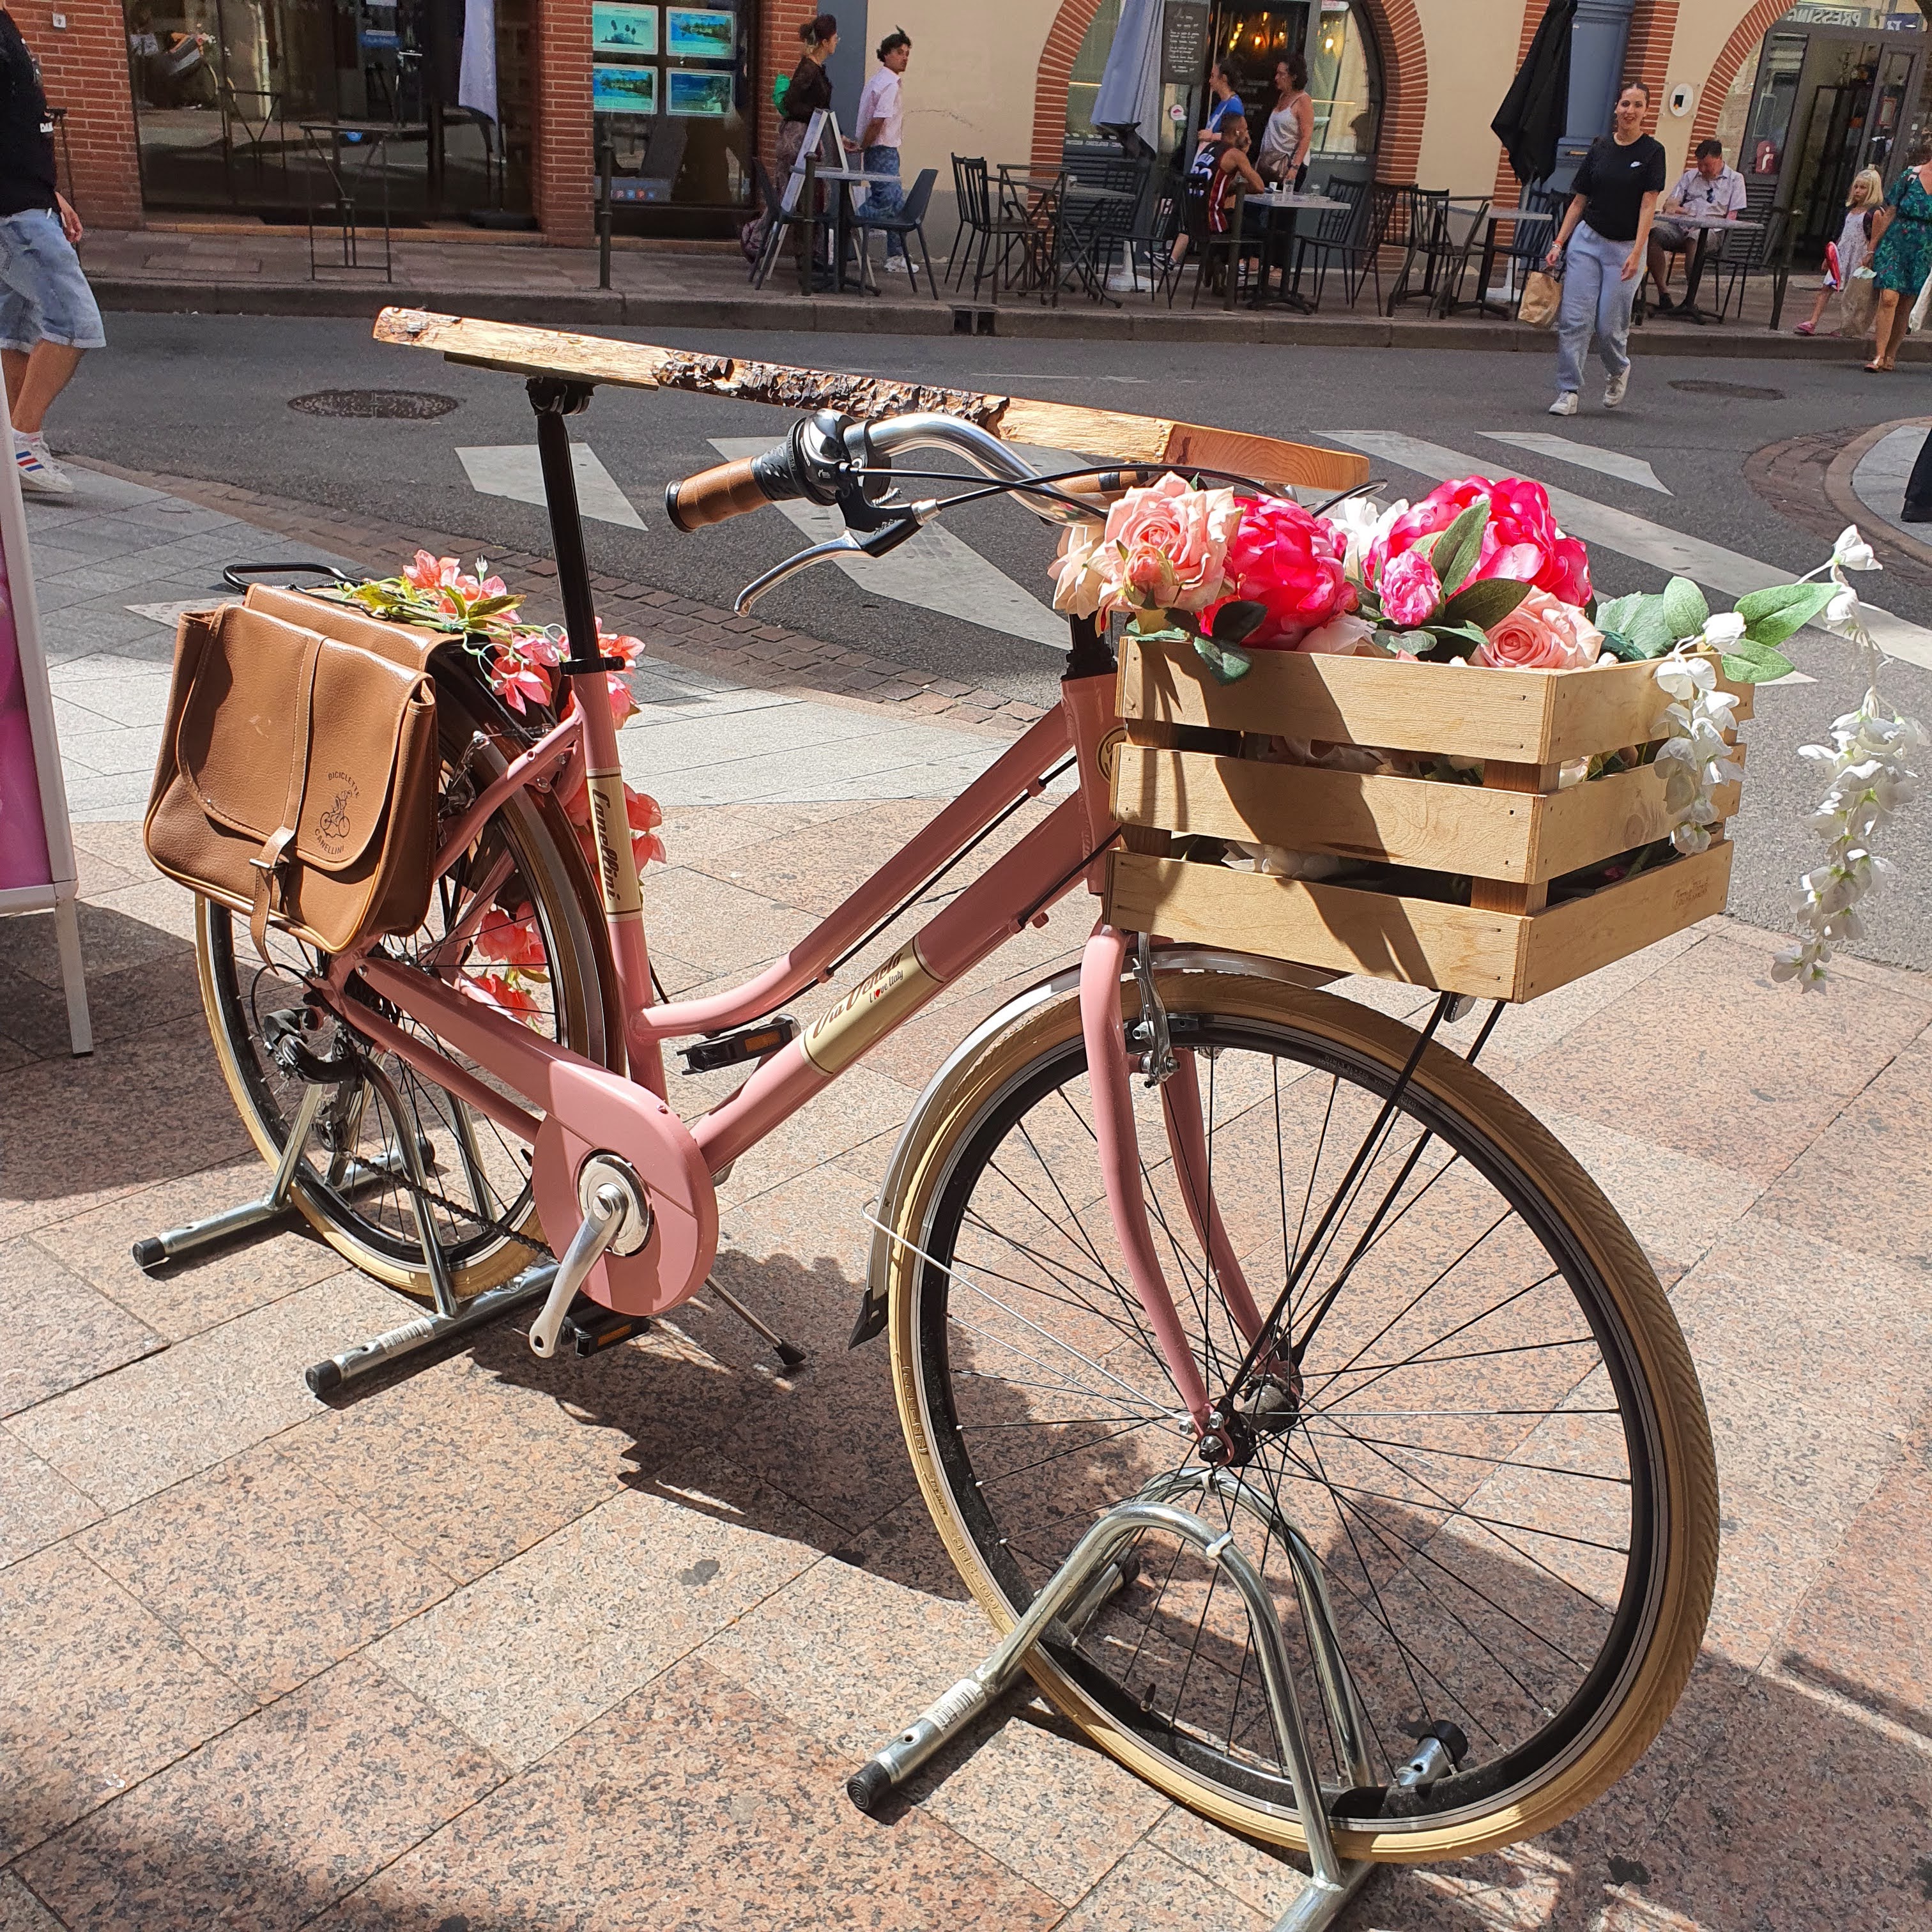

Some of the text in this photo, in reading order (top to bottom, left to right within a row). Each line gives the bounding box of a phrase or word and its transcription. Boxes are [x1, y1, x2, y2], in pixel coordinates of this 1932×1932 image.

[315, 828, 344, 855] CANELLINI
[592, 788, 621, 901] Canellini
[813, 1003, 845, 1039] Via
